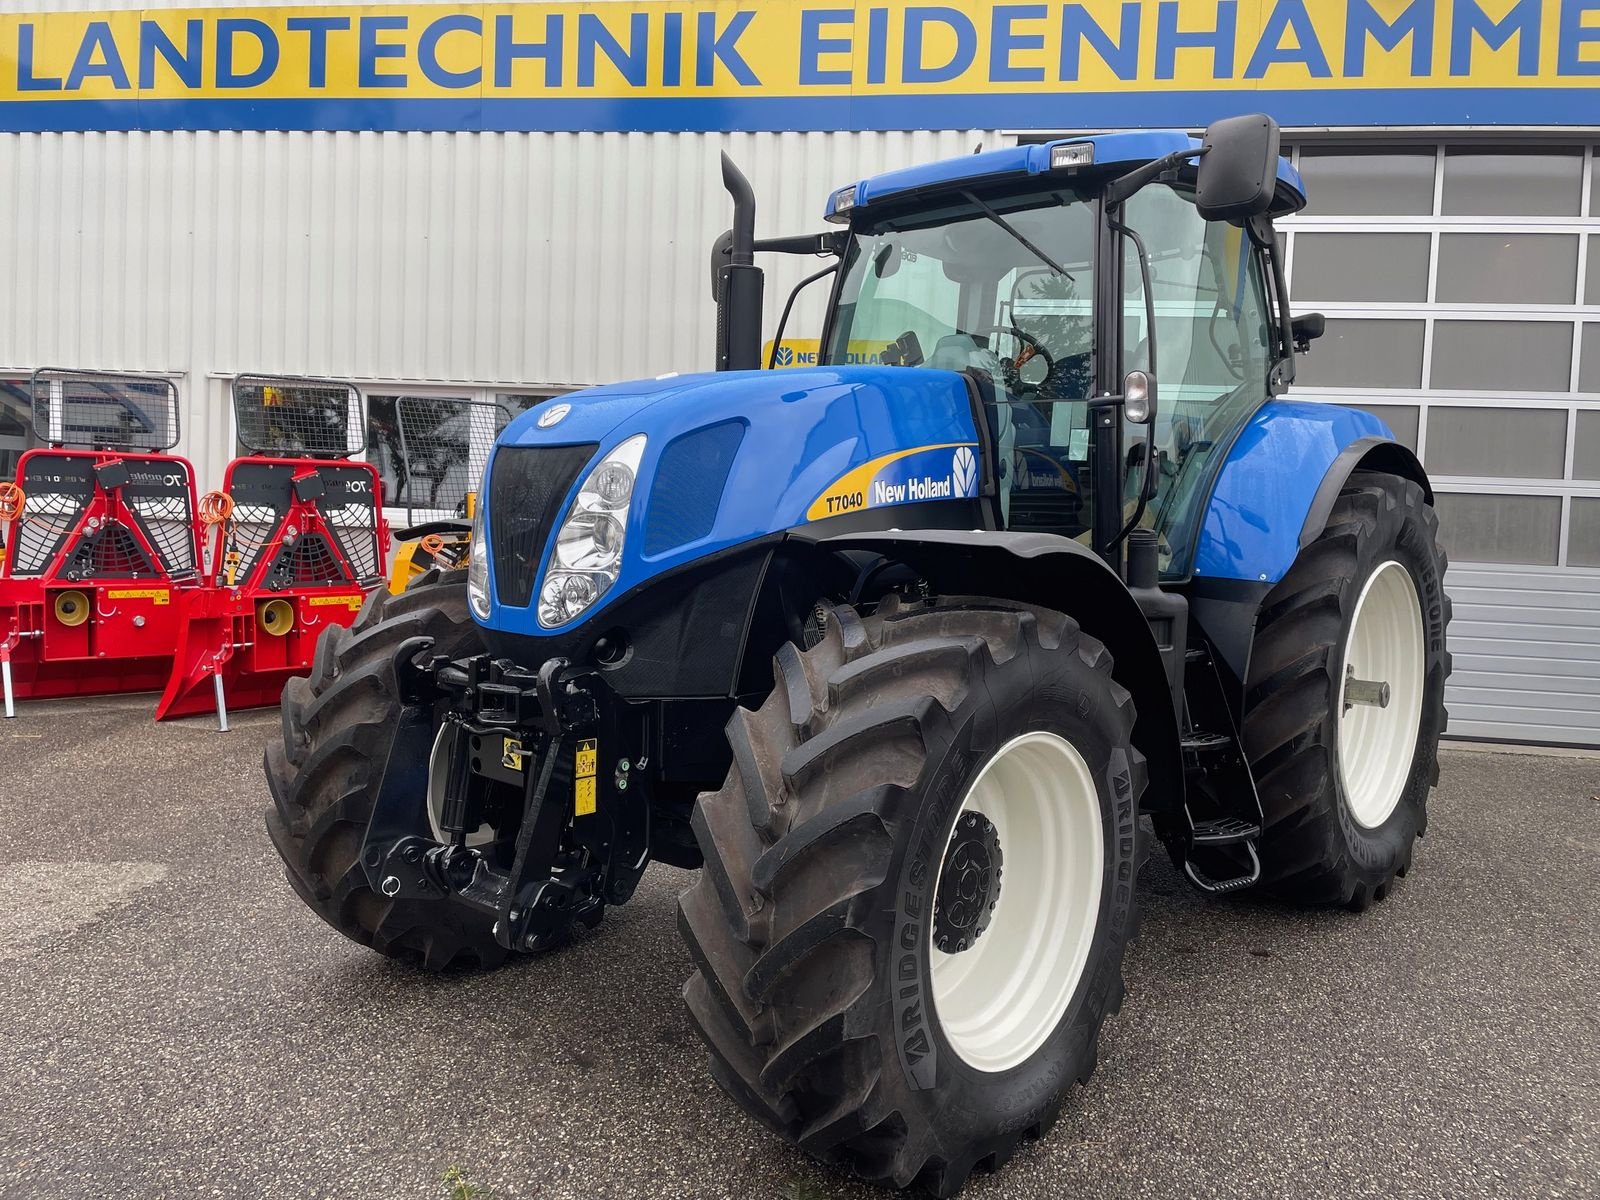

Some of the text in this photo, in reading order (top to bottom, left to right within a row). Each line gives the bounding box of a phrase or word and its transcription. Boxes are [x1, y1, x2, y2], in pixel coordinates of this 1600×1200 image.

[16, 11, 763, 91] LANDTECHNIK
[797, 352, 819, 363] NE
[826, 475, 951, 513] T7040 New Holland
[900, 747, 968, 1067] BRIDGESTONE
